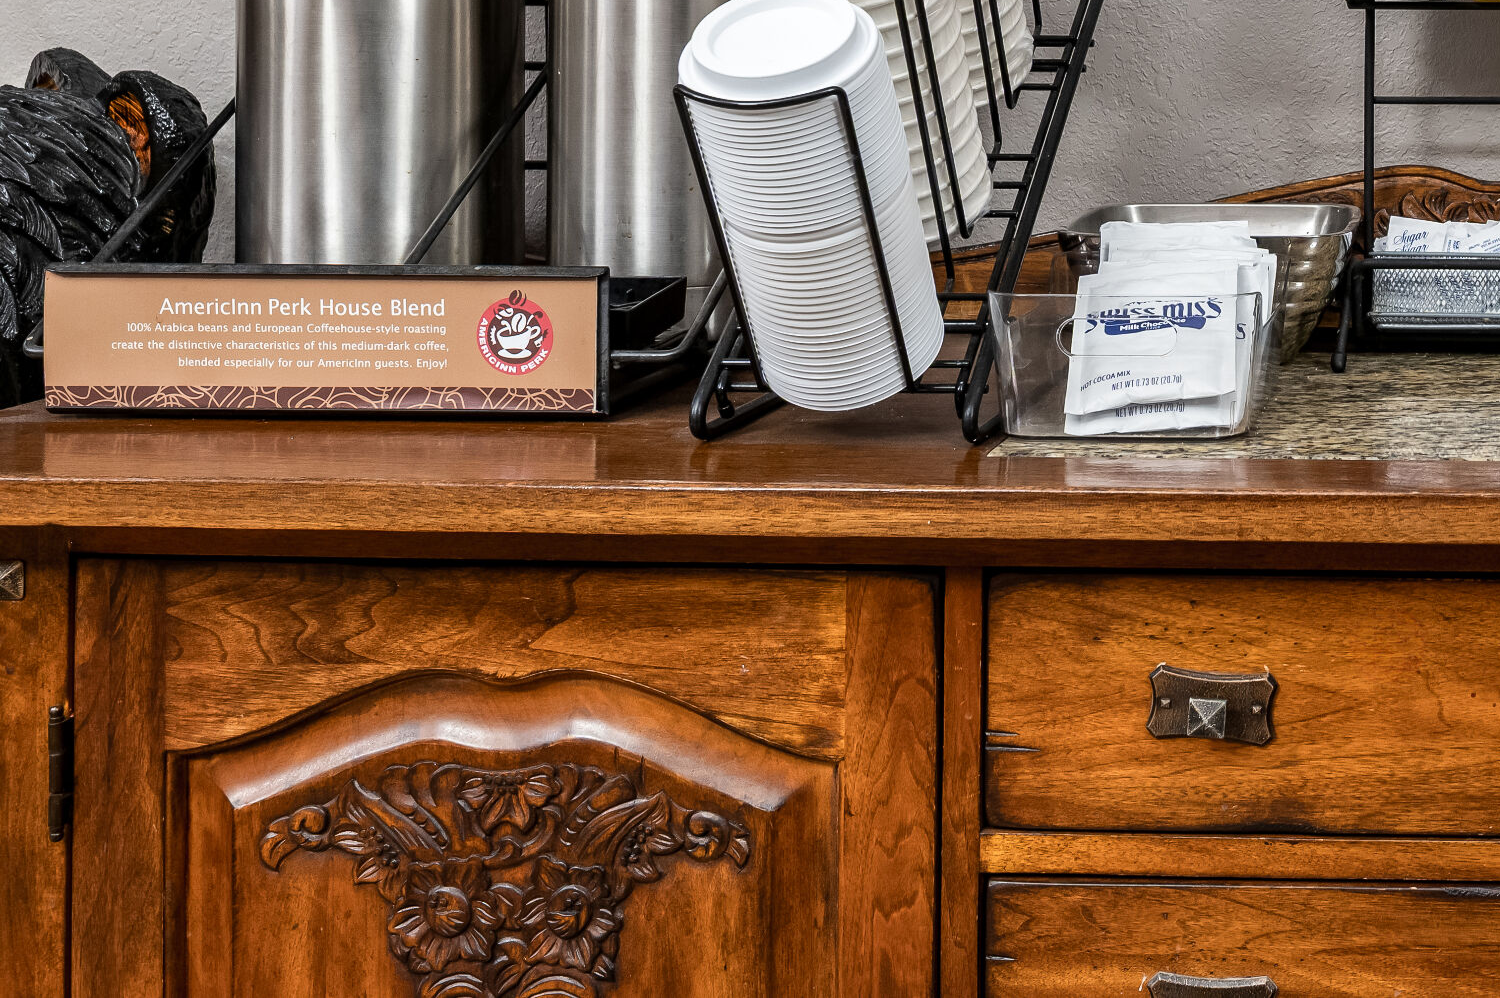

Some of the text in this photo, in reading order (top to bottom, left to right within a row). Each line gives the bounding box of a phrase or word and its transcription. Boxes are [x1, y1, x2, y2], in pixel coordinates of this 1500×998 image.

[1394, 230, 1429, 245] Sugar
[159, 298, 445, 316] AmericInn Perk House Blend
[127, 323, 447, 335] 100% Arabica beans and European Coffeehouse-style roasting
[112, 340, 448, 352] create the distinctive characteristics of this medium-dark coffee,
[479, 318, 548, 373] AMERICINN PERK
[178, 357, 220, 367] blended
[224, 357, 274, 369] especially
[278, 358, 292, 367] for
[318, 359, 371, 368] AmericInn
[374, 360, 412, 369] guests.
[416, 359, 448, 369] Enjoy!
[1080, 380, 1092, 391] HOT
[1093, 373, 1115, 384] COCOA
[1112, 382, 1123, 391] NET
[1124, 380, 1134, 388] WT
[1136, 378, 1150, 387] 0.73
[1151, 377, 1159, 385] OZ
[1116, 408, 1126, 417] NET
[1128, 406, 1138, 416] WT
[1154, 404, 1162, 412] OZ
